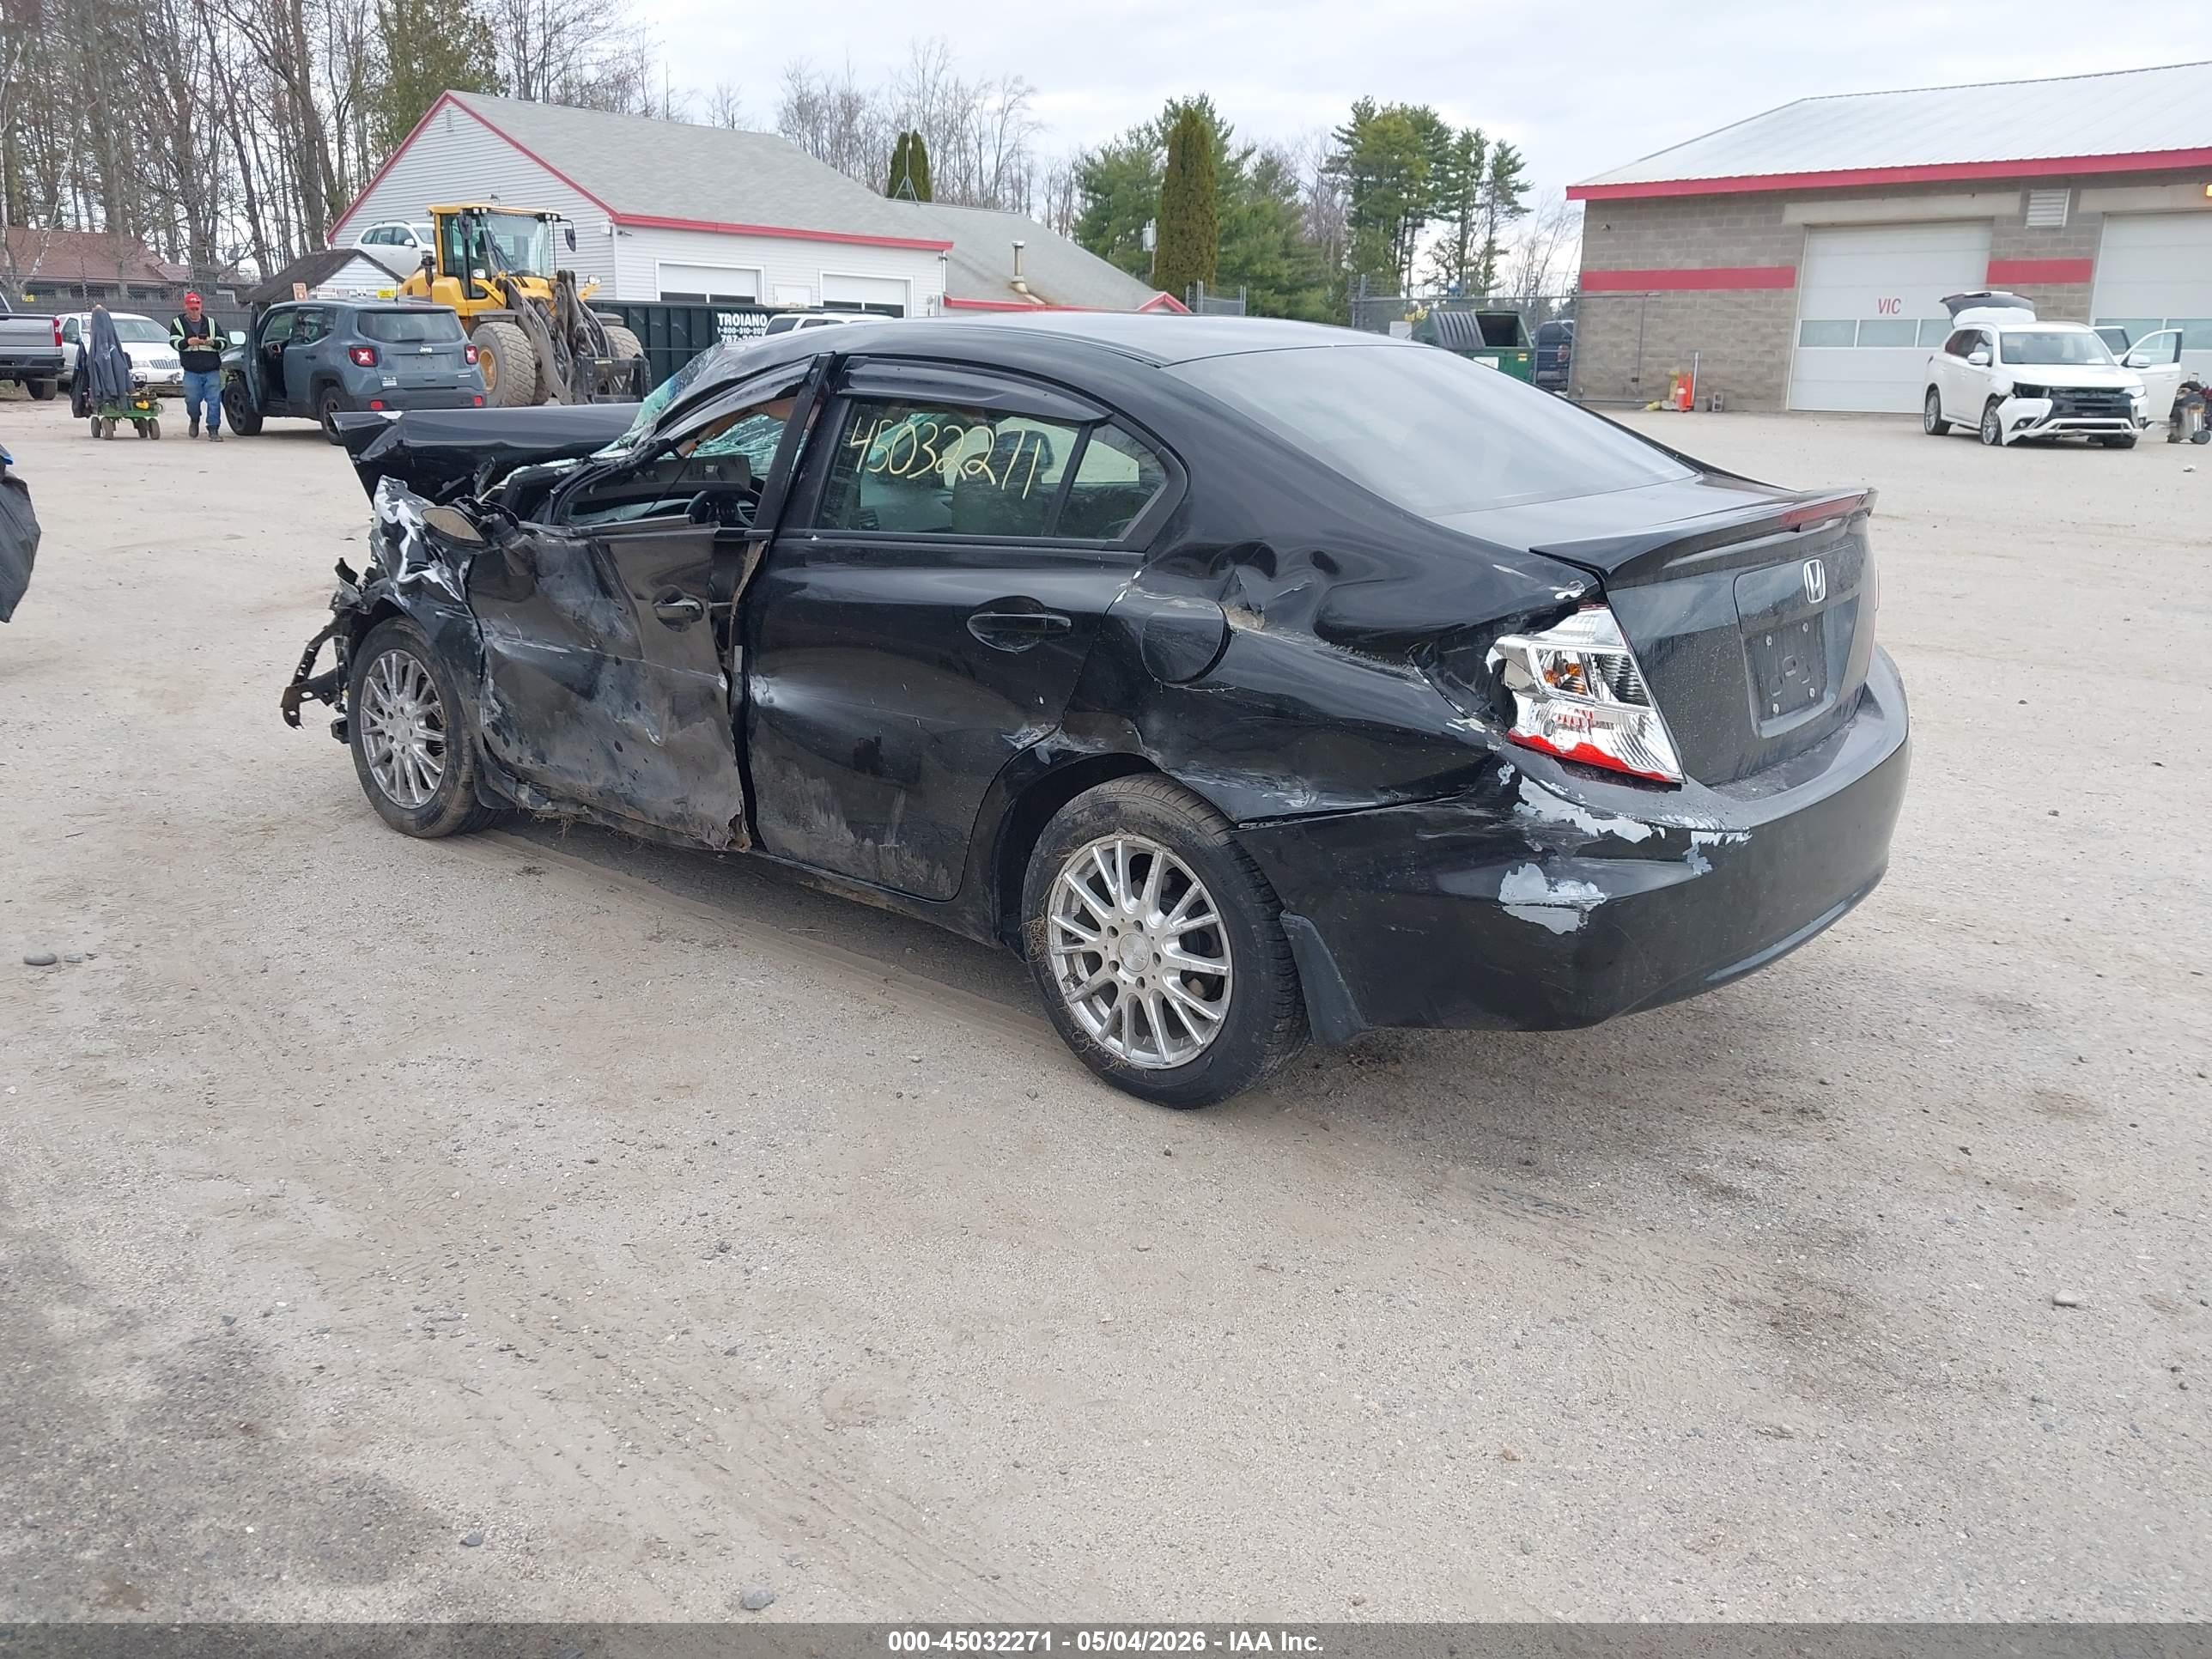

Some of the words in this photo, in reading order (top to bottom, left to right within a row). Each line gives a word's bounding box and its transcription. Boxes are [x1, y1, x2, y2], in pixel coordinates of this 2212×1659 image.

[1878, 298, 1901, 315] VIC
[717, 313, 768, 326] TROIANO
[850, 416, 1042, 500] 45032271
